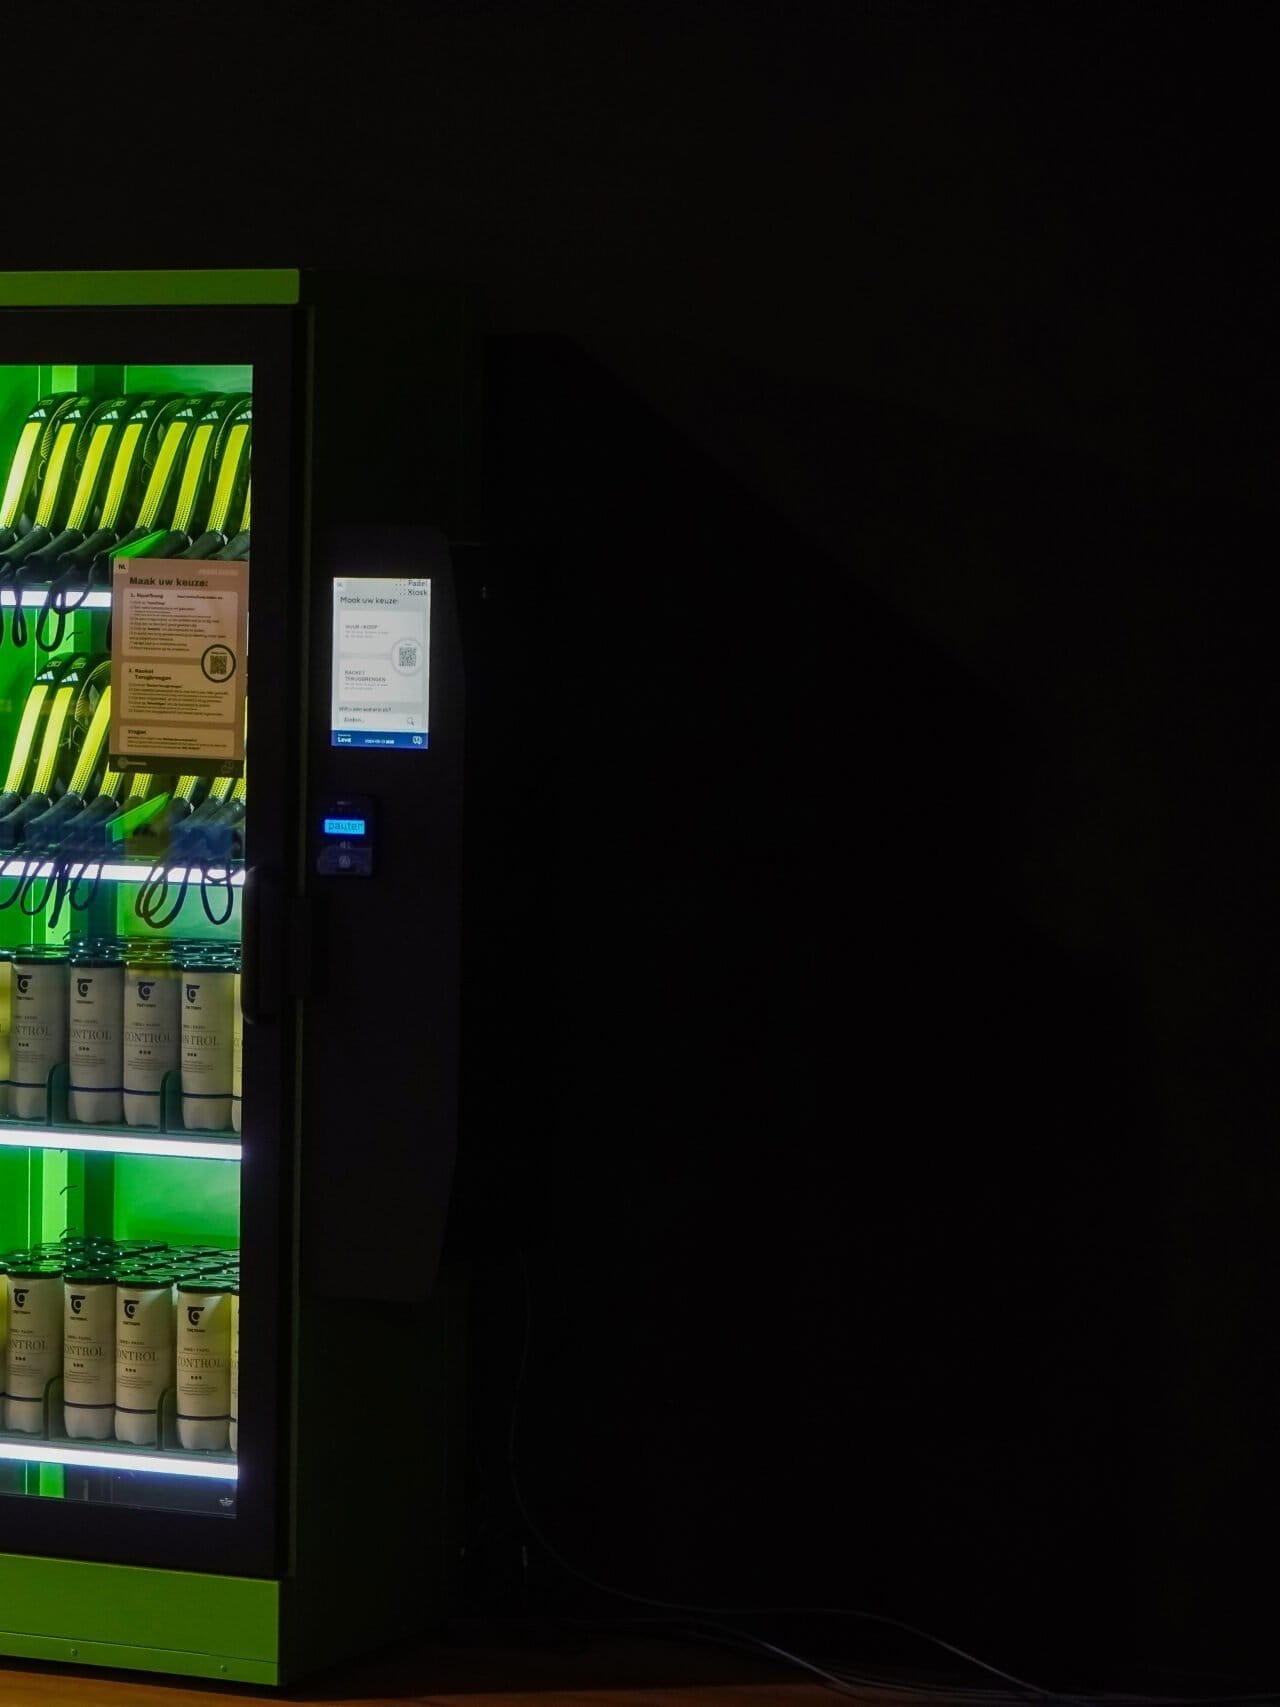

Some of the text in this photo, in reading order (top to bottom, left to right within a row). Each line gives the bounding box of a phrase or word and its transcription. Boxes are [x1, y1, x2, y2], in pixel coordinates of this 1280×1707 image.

[129, 577, 208, 587] Maak uw keuze:
[340, 596, 361, 604] Maak
